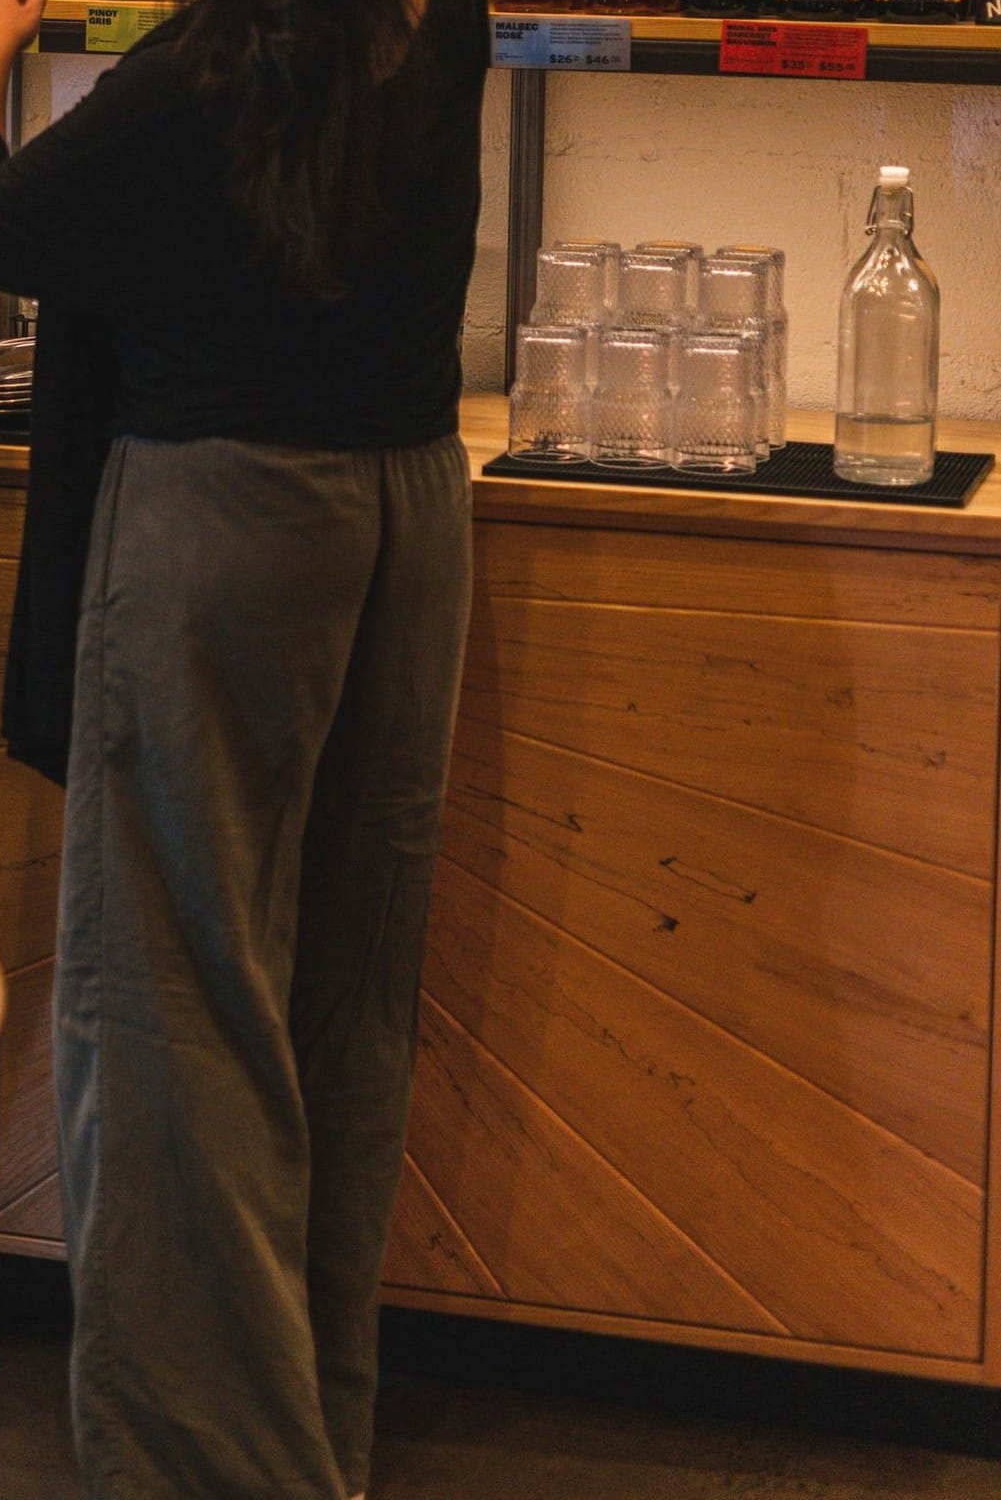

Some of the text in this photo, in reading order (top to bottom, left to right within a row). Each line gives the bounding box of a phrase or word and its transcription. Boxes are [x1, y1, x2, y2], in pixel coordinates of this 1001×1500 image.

[88, 8, 118, 17] PINOT
[88, 17, 112, 26] GRIS
[495, 22, 539, 31] MALBEC
[495, 30, 523, 40] ROSÉ
[549, 54, 609, 65] $26 $46
